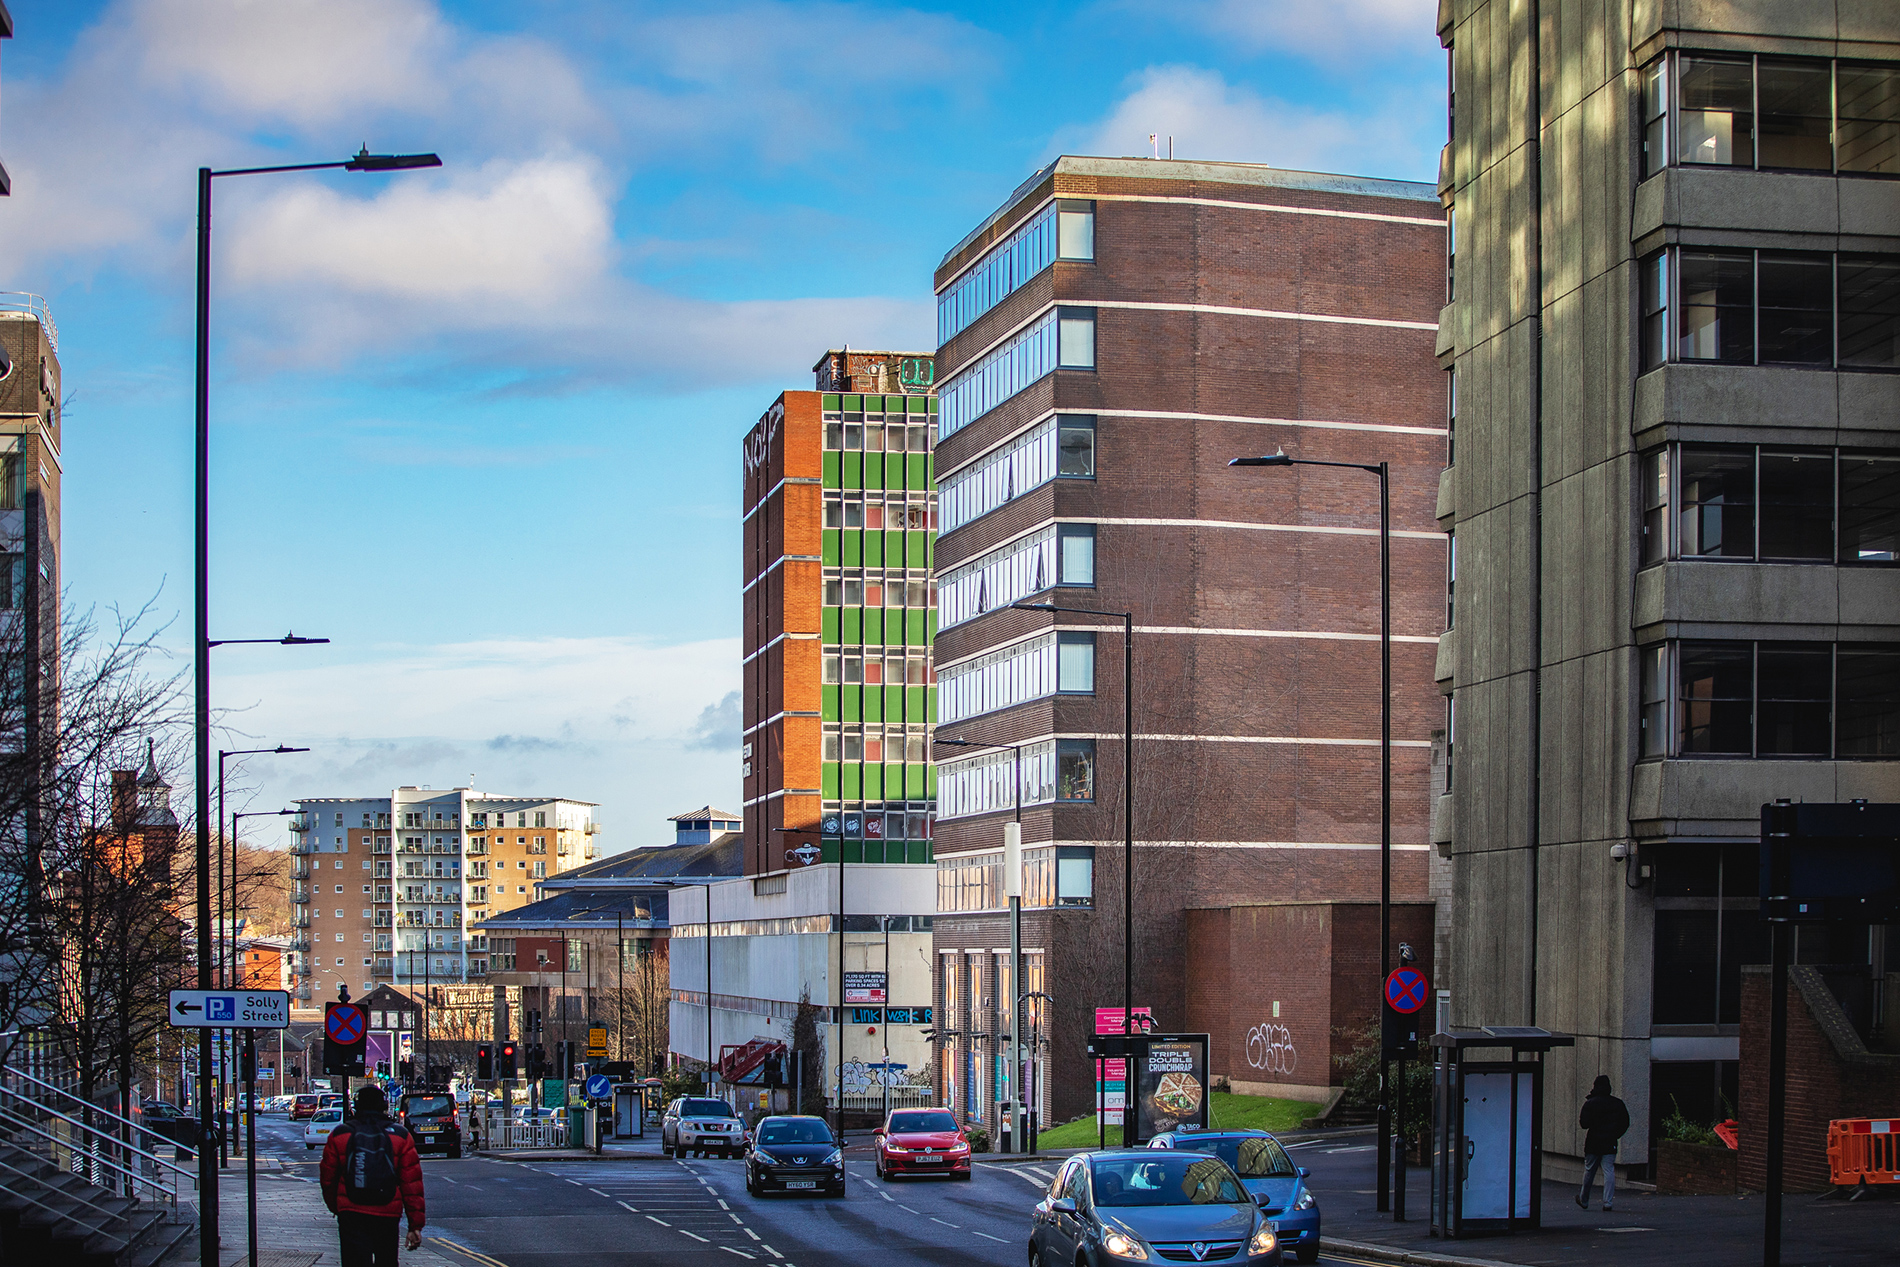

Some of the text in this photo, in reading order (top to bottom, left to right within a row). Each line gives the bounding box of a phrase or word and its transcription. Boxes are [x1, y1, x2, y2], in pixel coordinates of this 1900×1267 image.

[246, 996, 279, 1009] Solly
[209, 999, 225, 1019] P
[217, 1011, 232, 1019] 550
[242, 1010, 283, 1021] Street
[1148, 1063, 1193, 1072] CRUNCHWRAP
[355, 1151, 366, 1174] PUMA
